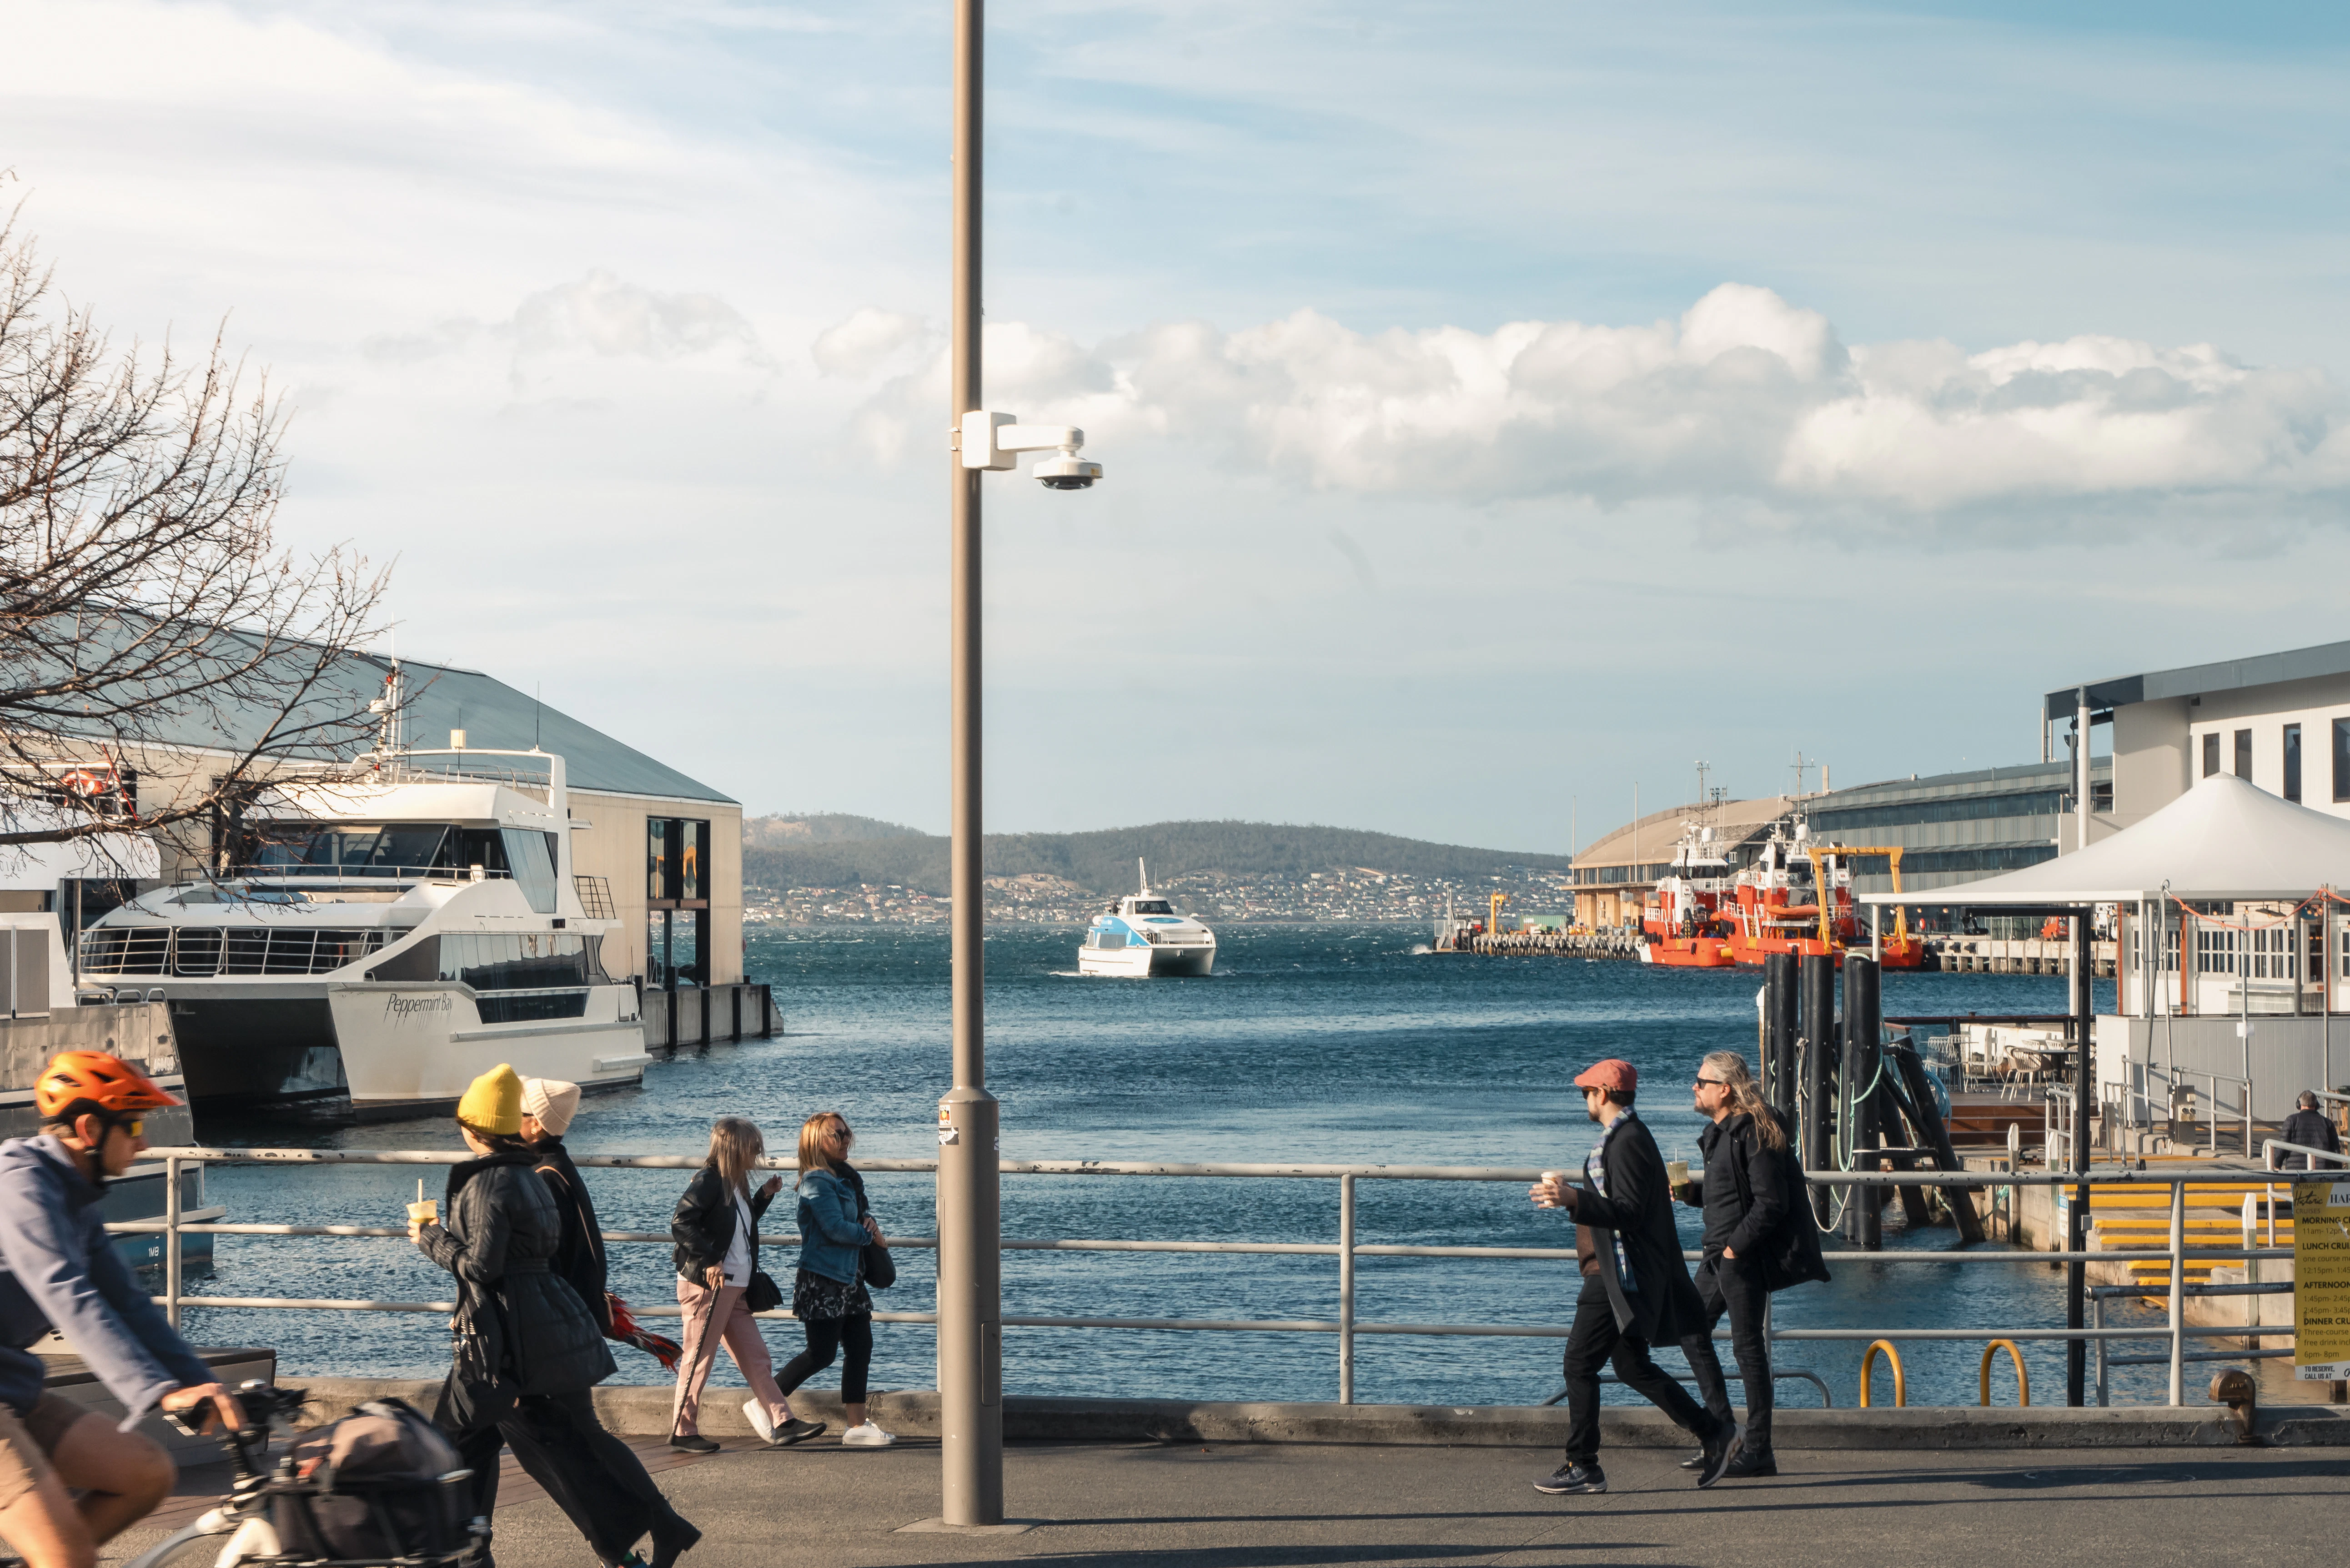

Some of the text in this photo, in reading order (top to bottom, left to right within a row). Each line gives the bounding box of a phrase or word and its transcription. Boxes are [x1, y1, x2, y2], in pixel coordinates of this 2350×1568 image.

[387, 993, 454, 1018] Peppermint Bay
[2324, 1351, 2340, 1359] 8pm
